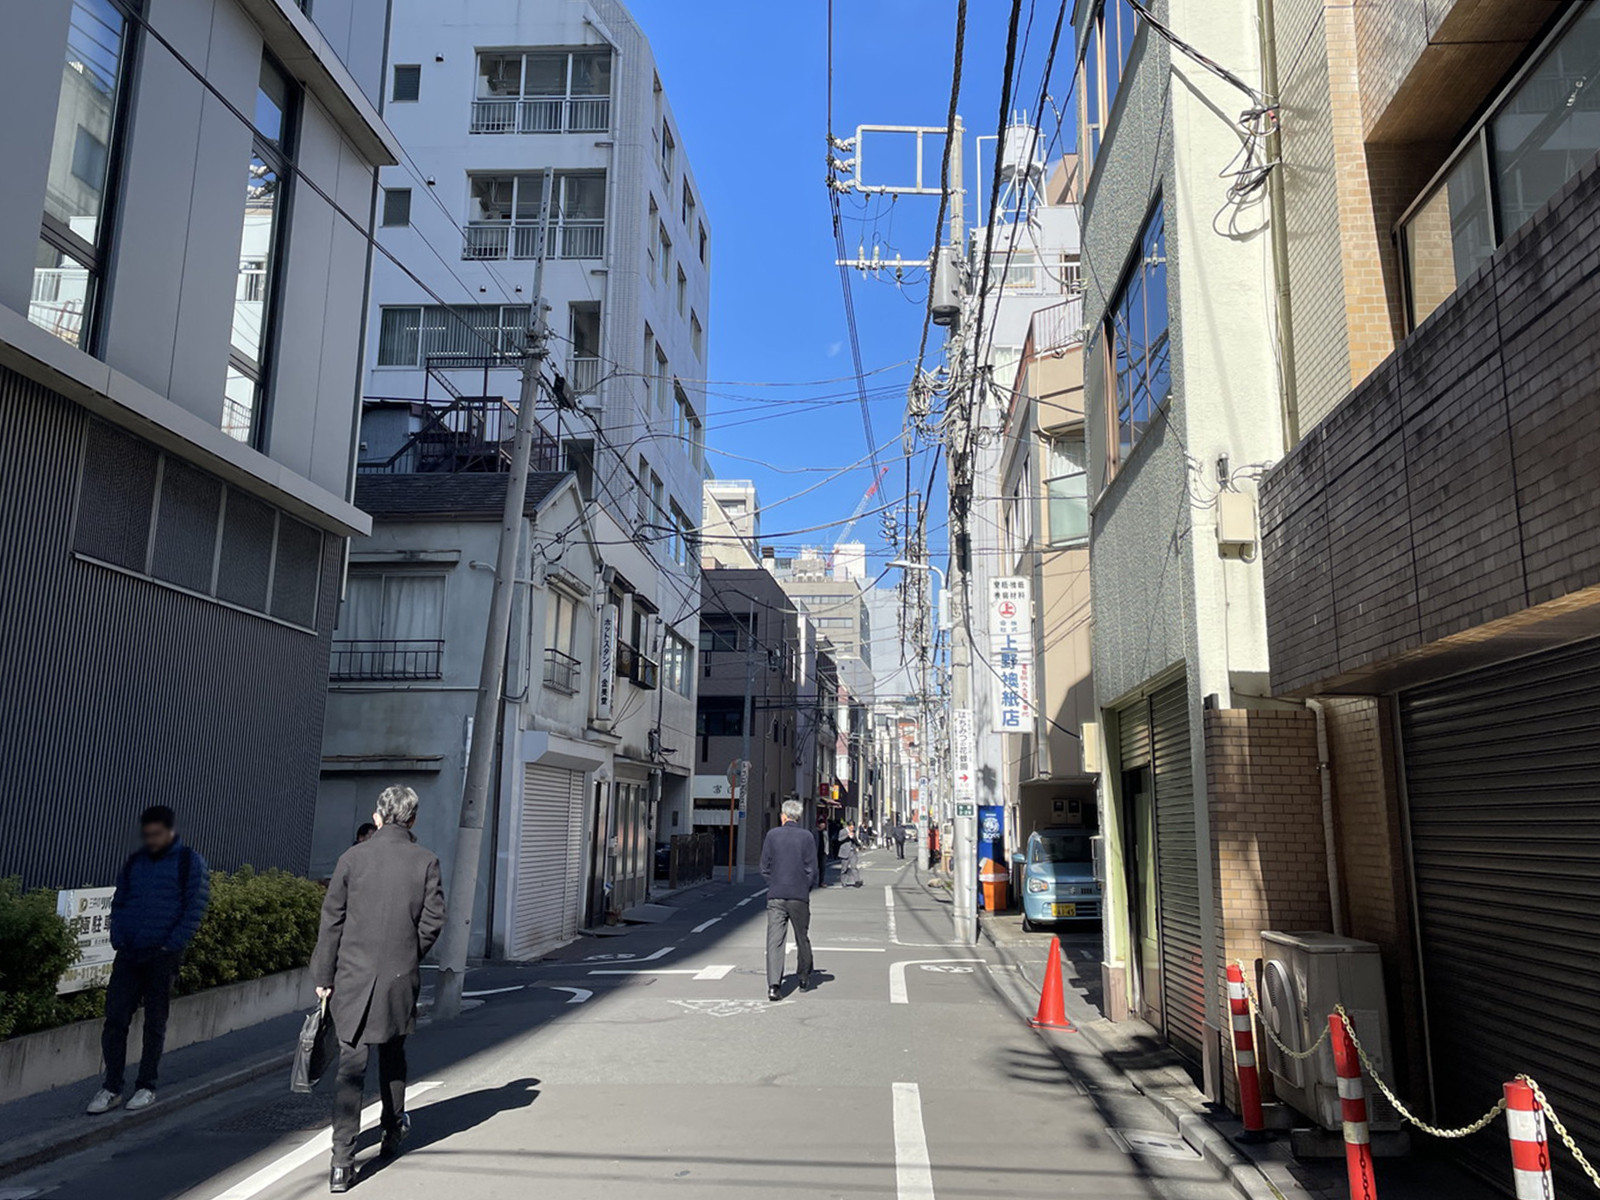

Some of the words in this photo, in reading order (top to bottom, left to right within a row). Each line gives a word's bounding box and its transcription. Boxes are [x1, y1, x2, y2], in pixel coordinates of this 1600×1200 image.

[602, 618, 611, 673] ホットスタンプ
